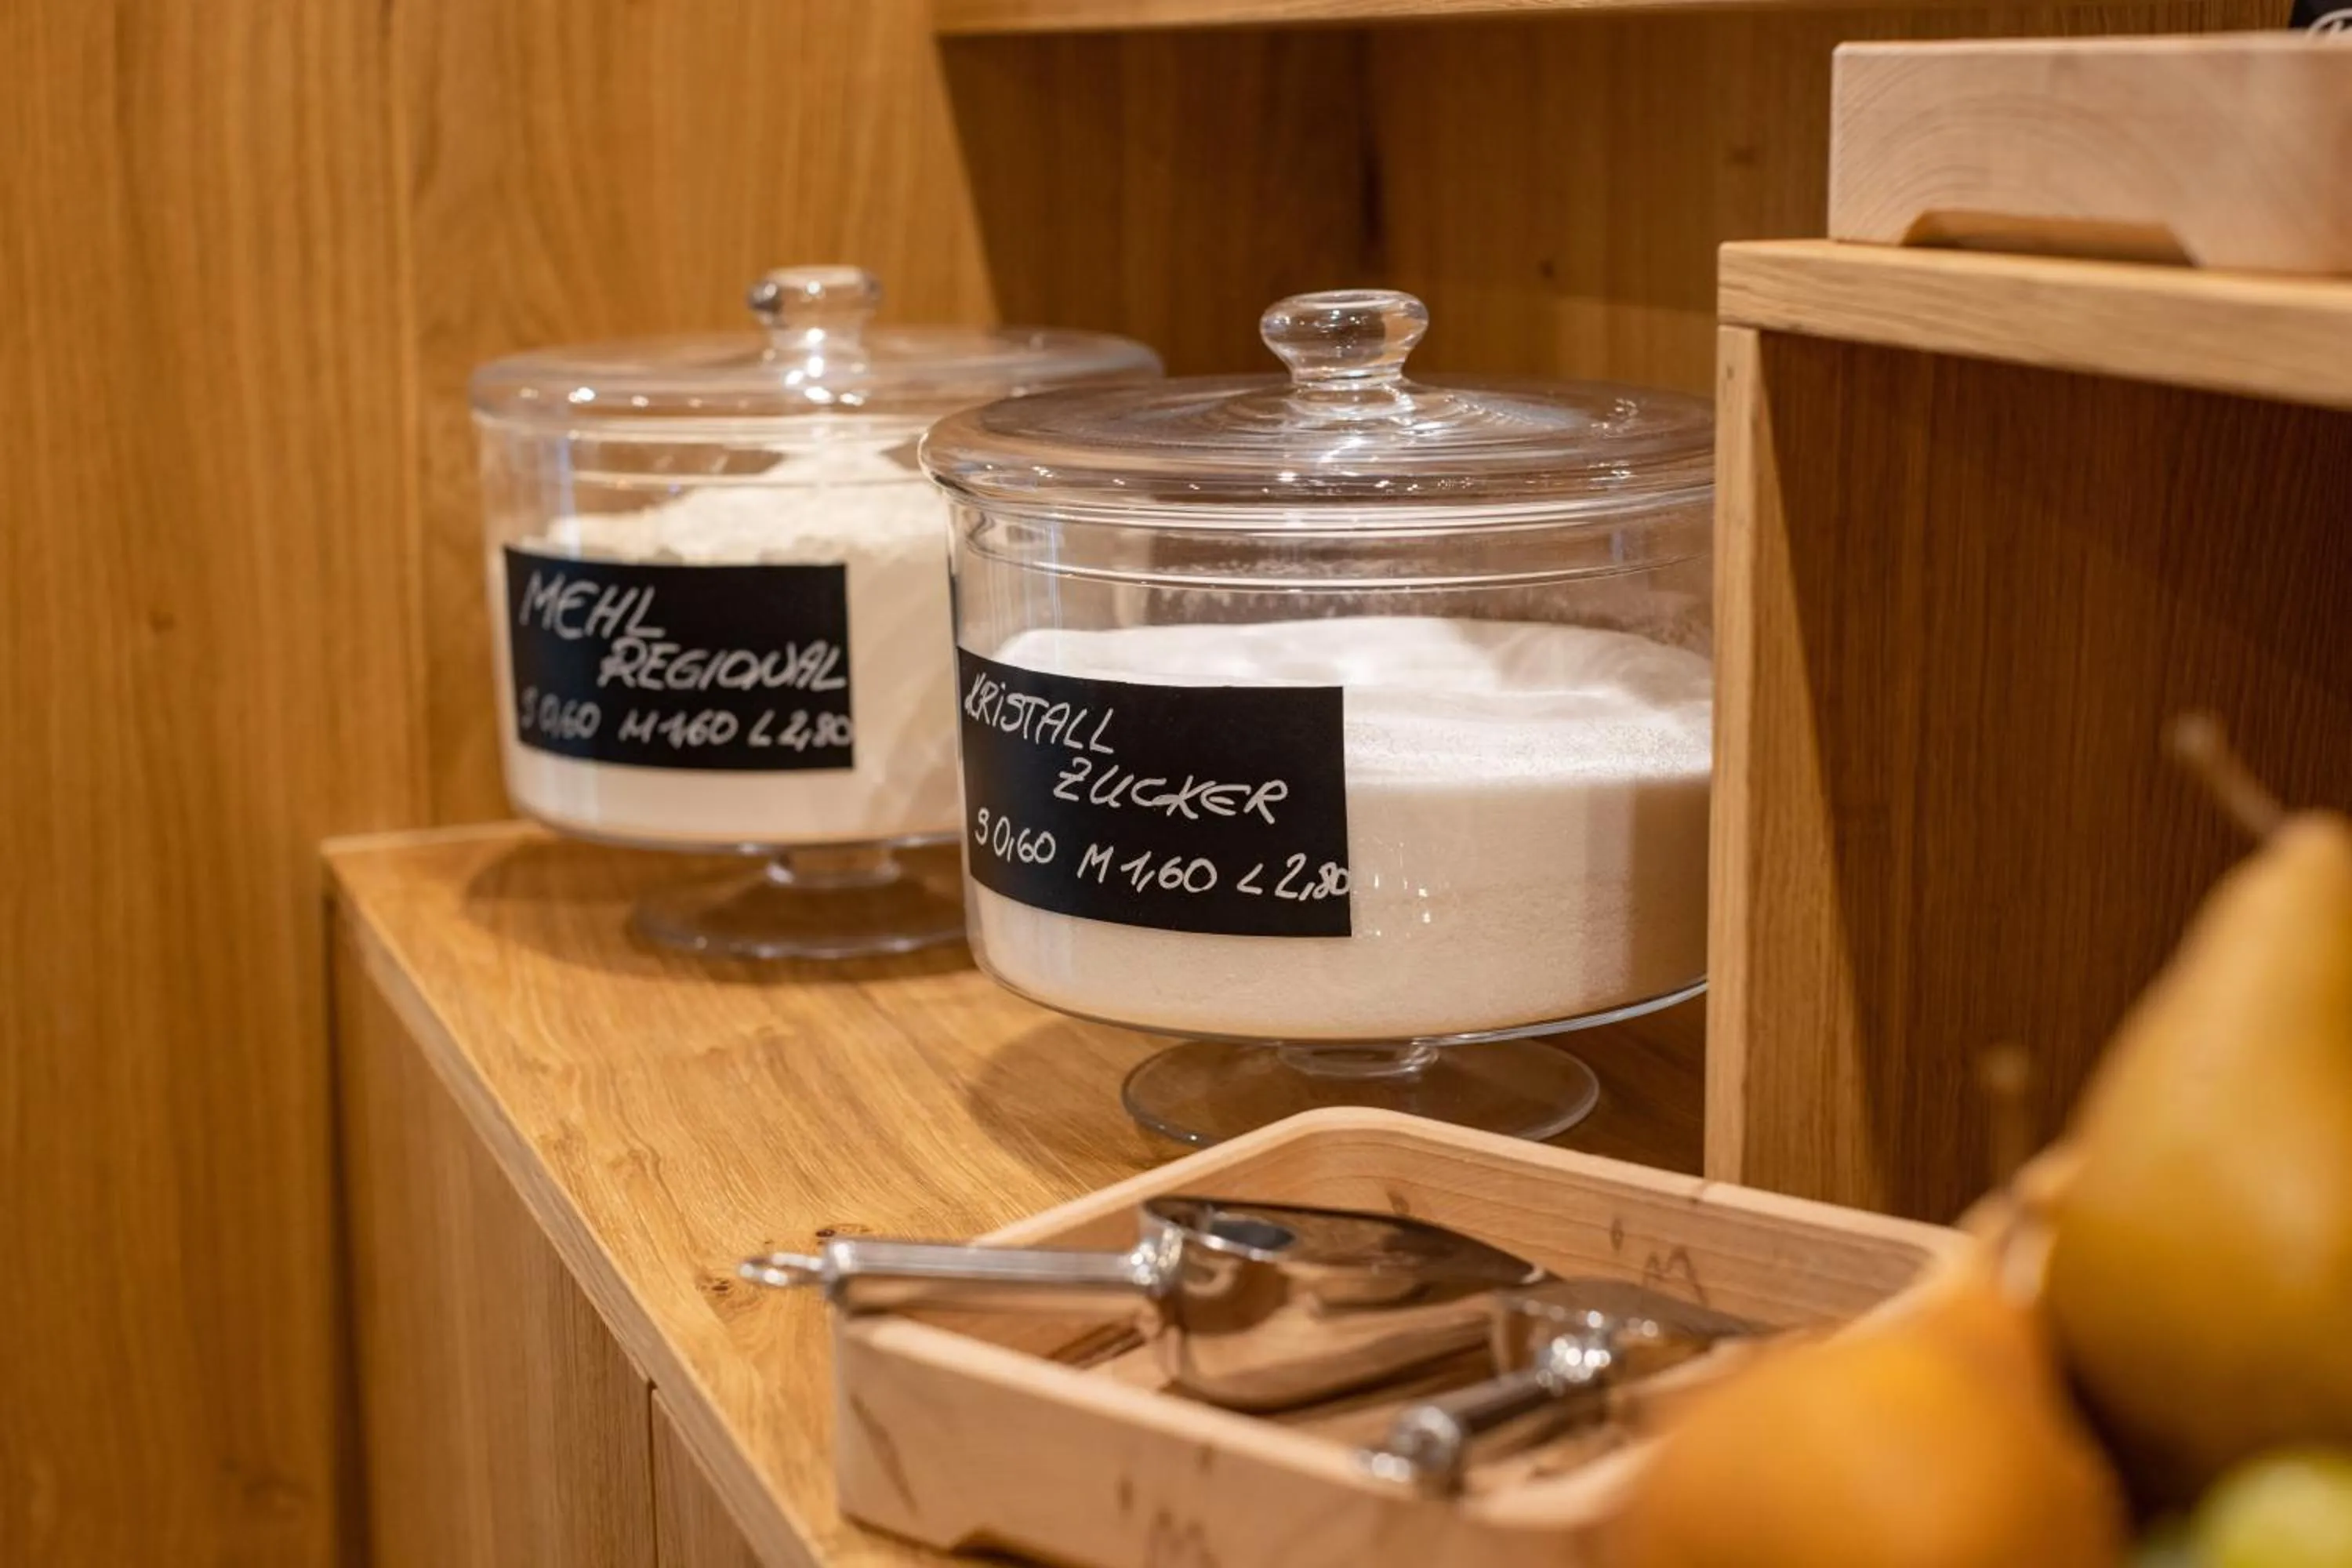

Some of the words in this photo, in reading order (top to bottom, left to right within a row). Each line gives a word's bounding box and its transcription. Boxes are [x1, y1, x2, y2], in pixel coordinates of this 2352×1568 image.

[519, 572, 666, 640] MEHL
[597, 635, 847, 691] REGIONAL
[619, 708, 660, 744] M
[747, 709, 775, 747] L
[1053, 757, 1288, 826] ZUCKER
[975, 808, 989, 846] S
[993, 816, 1056, 864] 0,60
[1076, 843, 1114, 884] M
[1120, 851, 1218, 893] 1,60
[1236, 862, 1264, 895] L
[1273, 851, 1351, 902] 2,80
